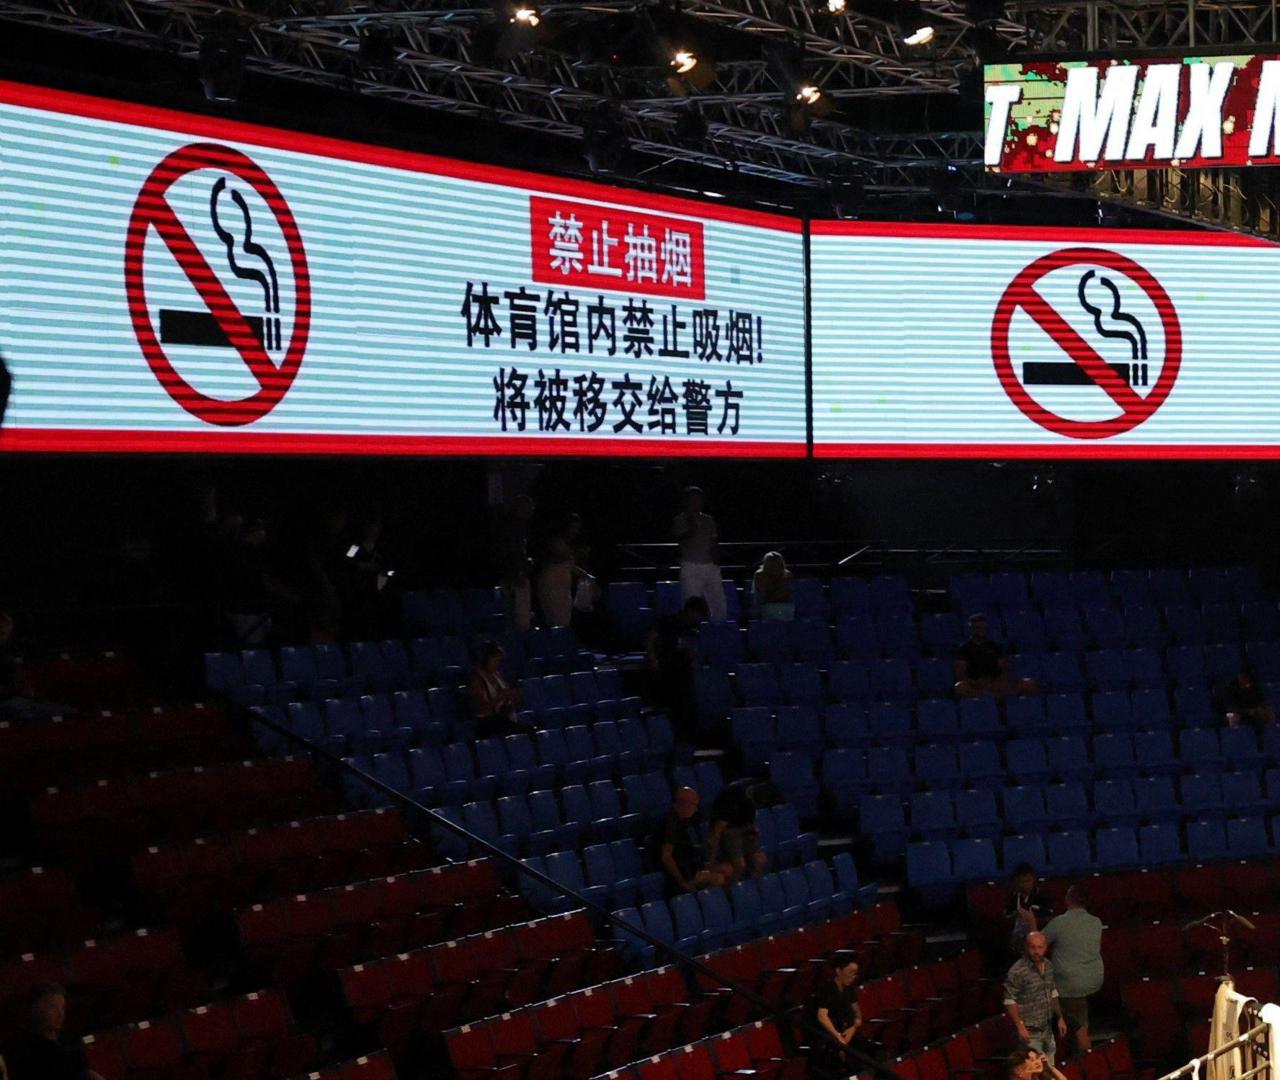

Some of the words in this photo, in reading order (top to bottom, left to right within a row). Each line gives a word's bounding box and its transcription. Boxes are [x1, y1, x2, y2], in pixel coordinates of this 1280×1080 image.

[1053, 64, 1237, 161] MAX
[548, 210, 693, 288] 禁止抽烟
[493, 367, 744, 436] 将被移交给警方
